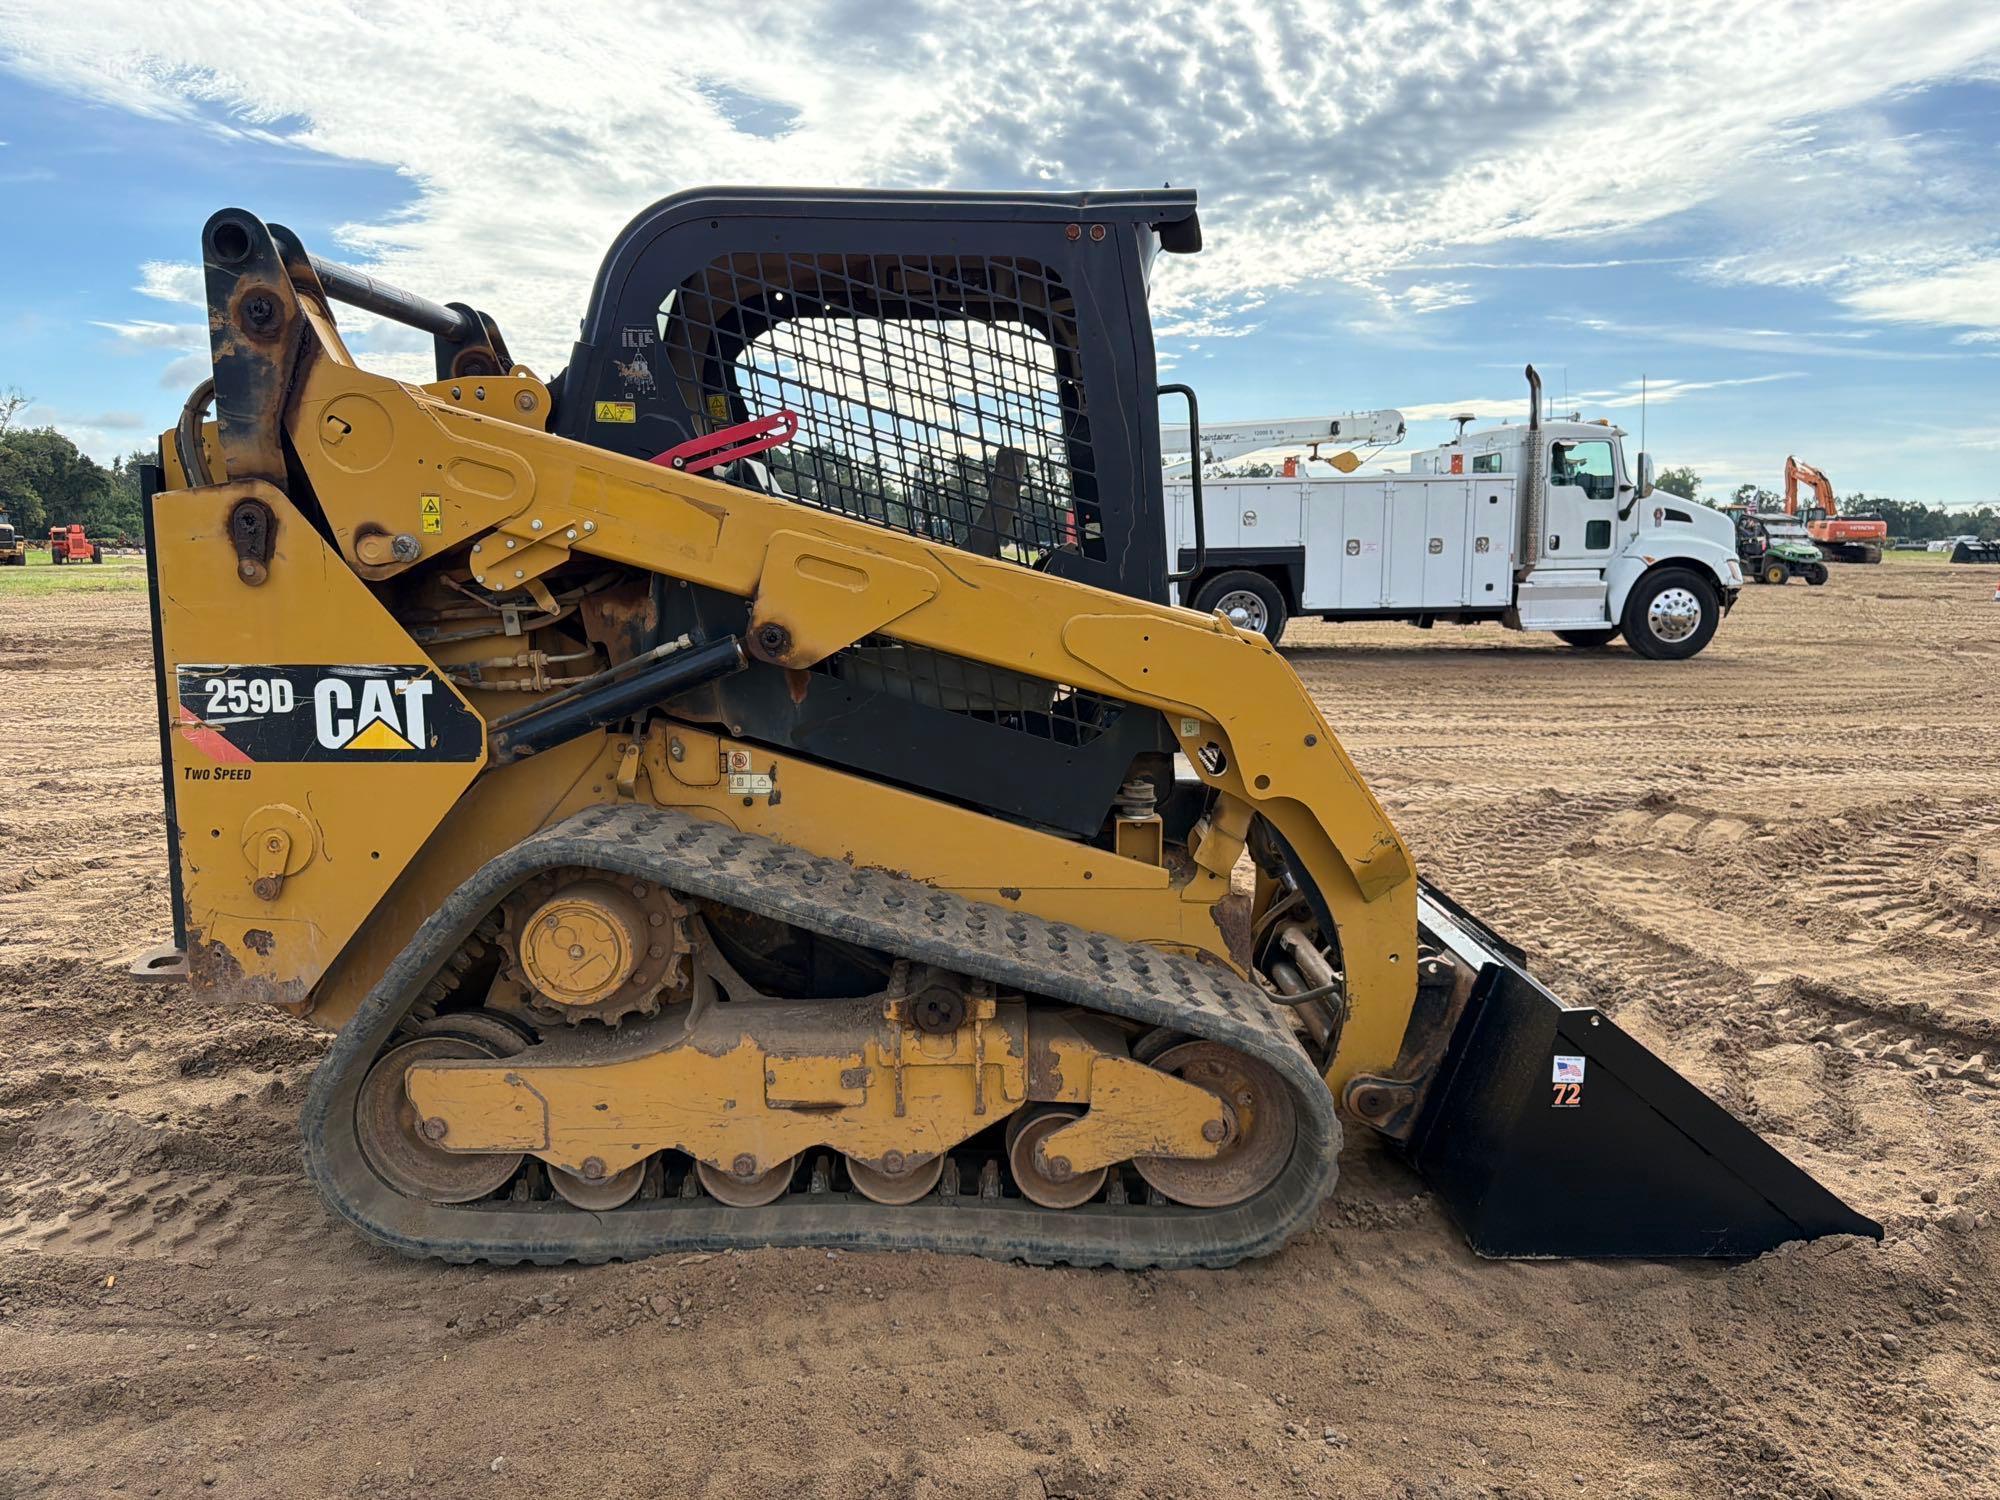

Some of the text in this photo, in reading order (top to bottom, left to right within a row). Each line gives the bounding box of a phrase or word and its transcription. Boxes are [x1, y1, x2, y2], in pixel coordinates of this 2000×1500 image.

[205, 679, 294, 714] 259D
[314, 678, 432, 750] CAT
[1553, 1083, 1581, 1105] 72
